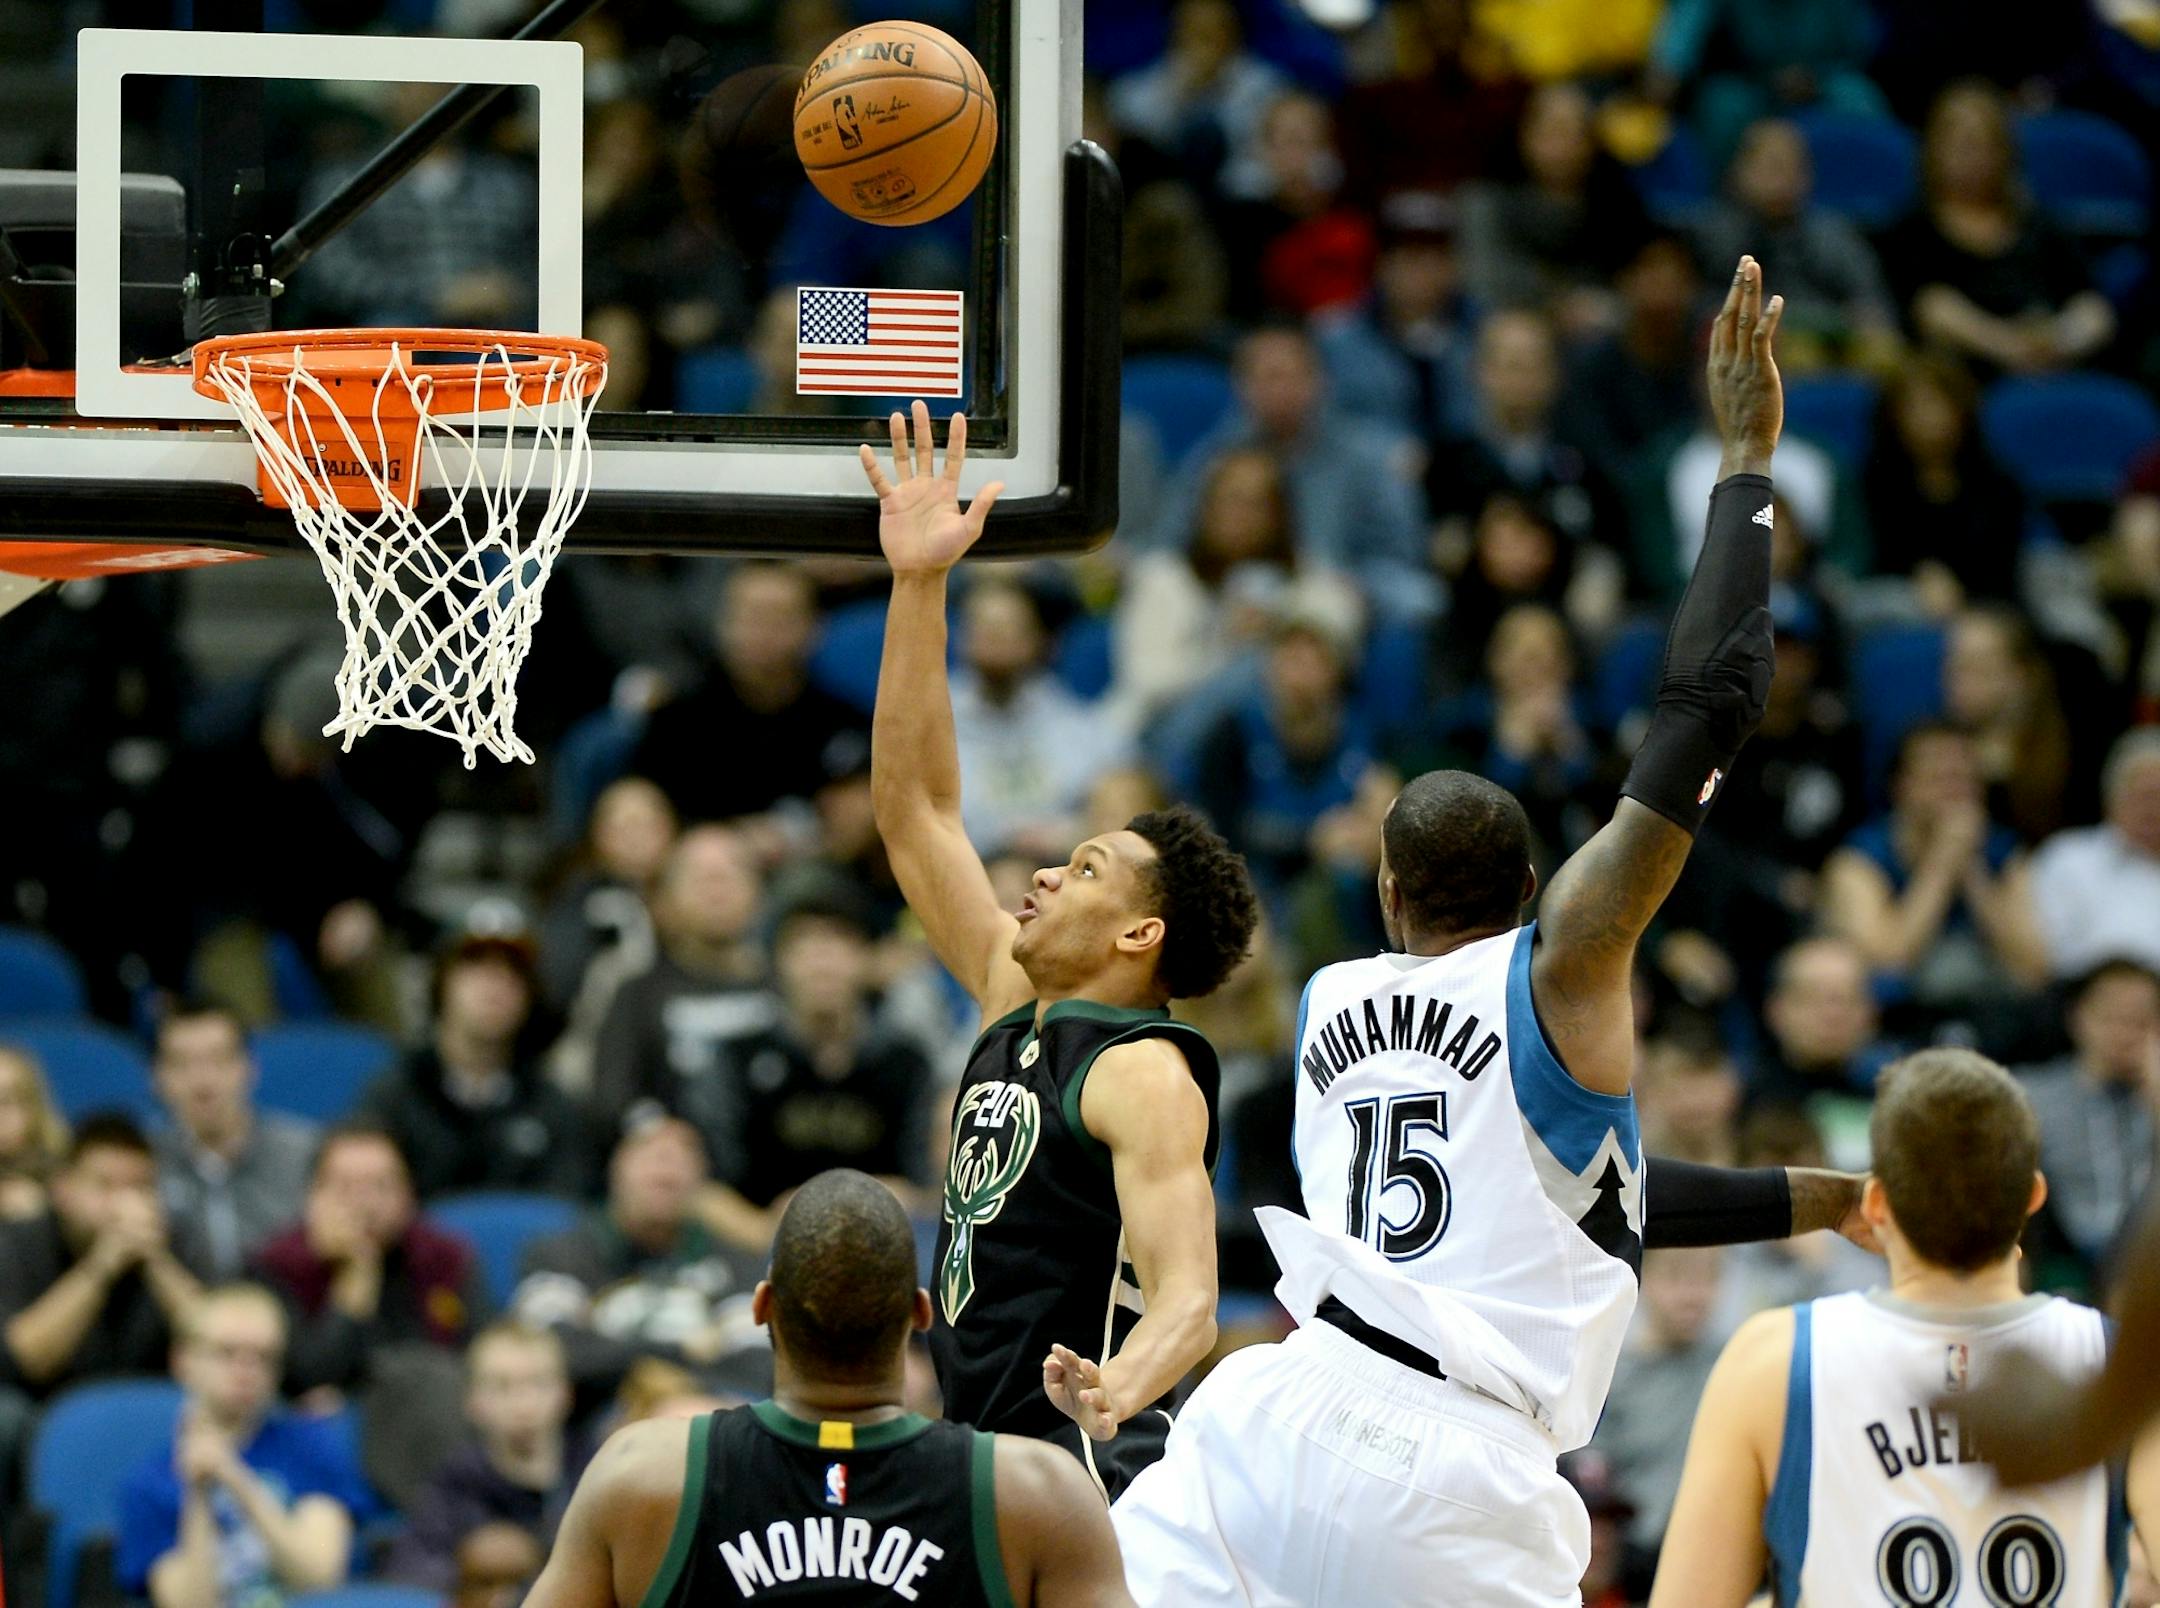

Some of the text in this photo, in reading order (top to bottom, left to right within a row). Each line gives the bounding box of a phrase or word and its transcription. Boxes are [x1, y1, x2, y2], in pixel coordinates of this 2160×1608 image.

[1302, 995, 1502, 1096] MUHAMMAD
[974, 1080, 1021, 1129] 20
[1345, 1091, 1451, 1263] 15
[718, 1517, 945, 1602] MONROE
